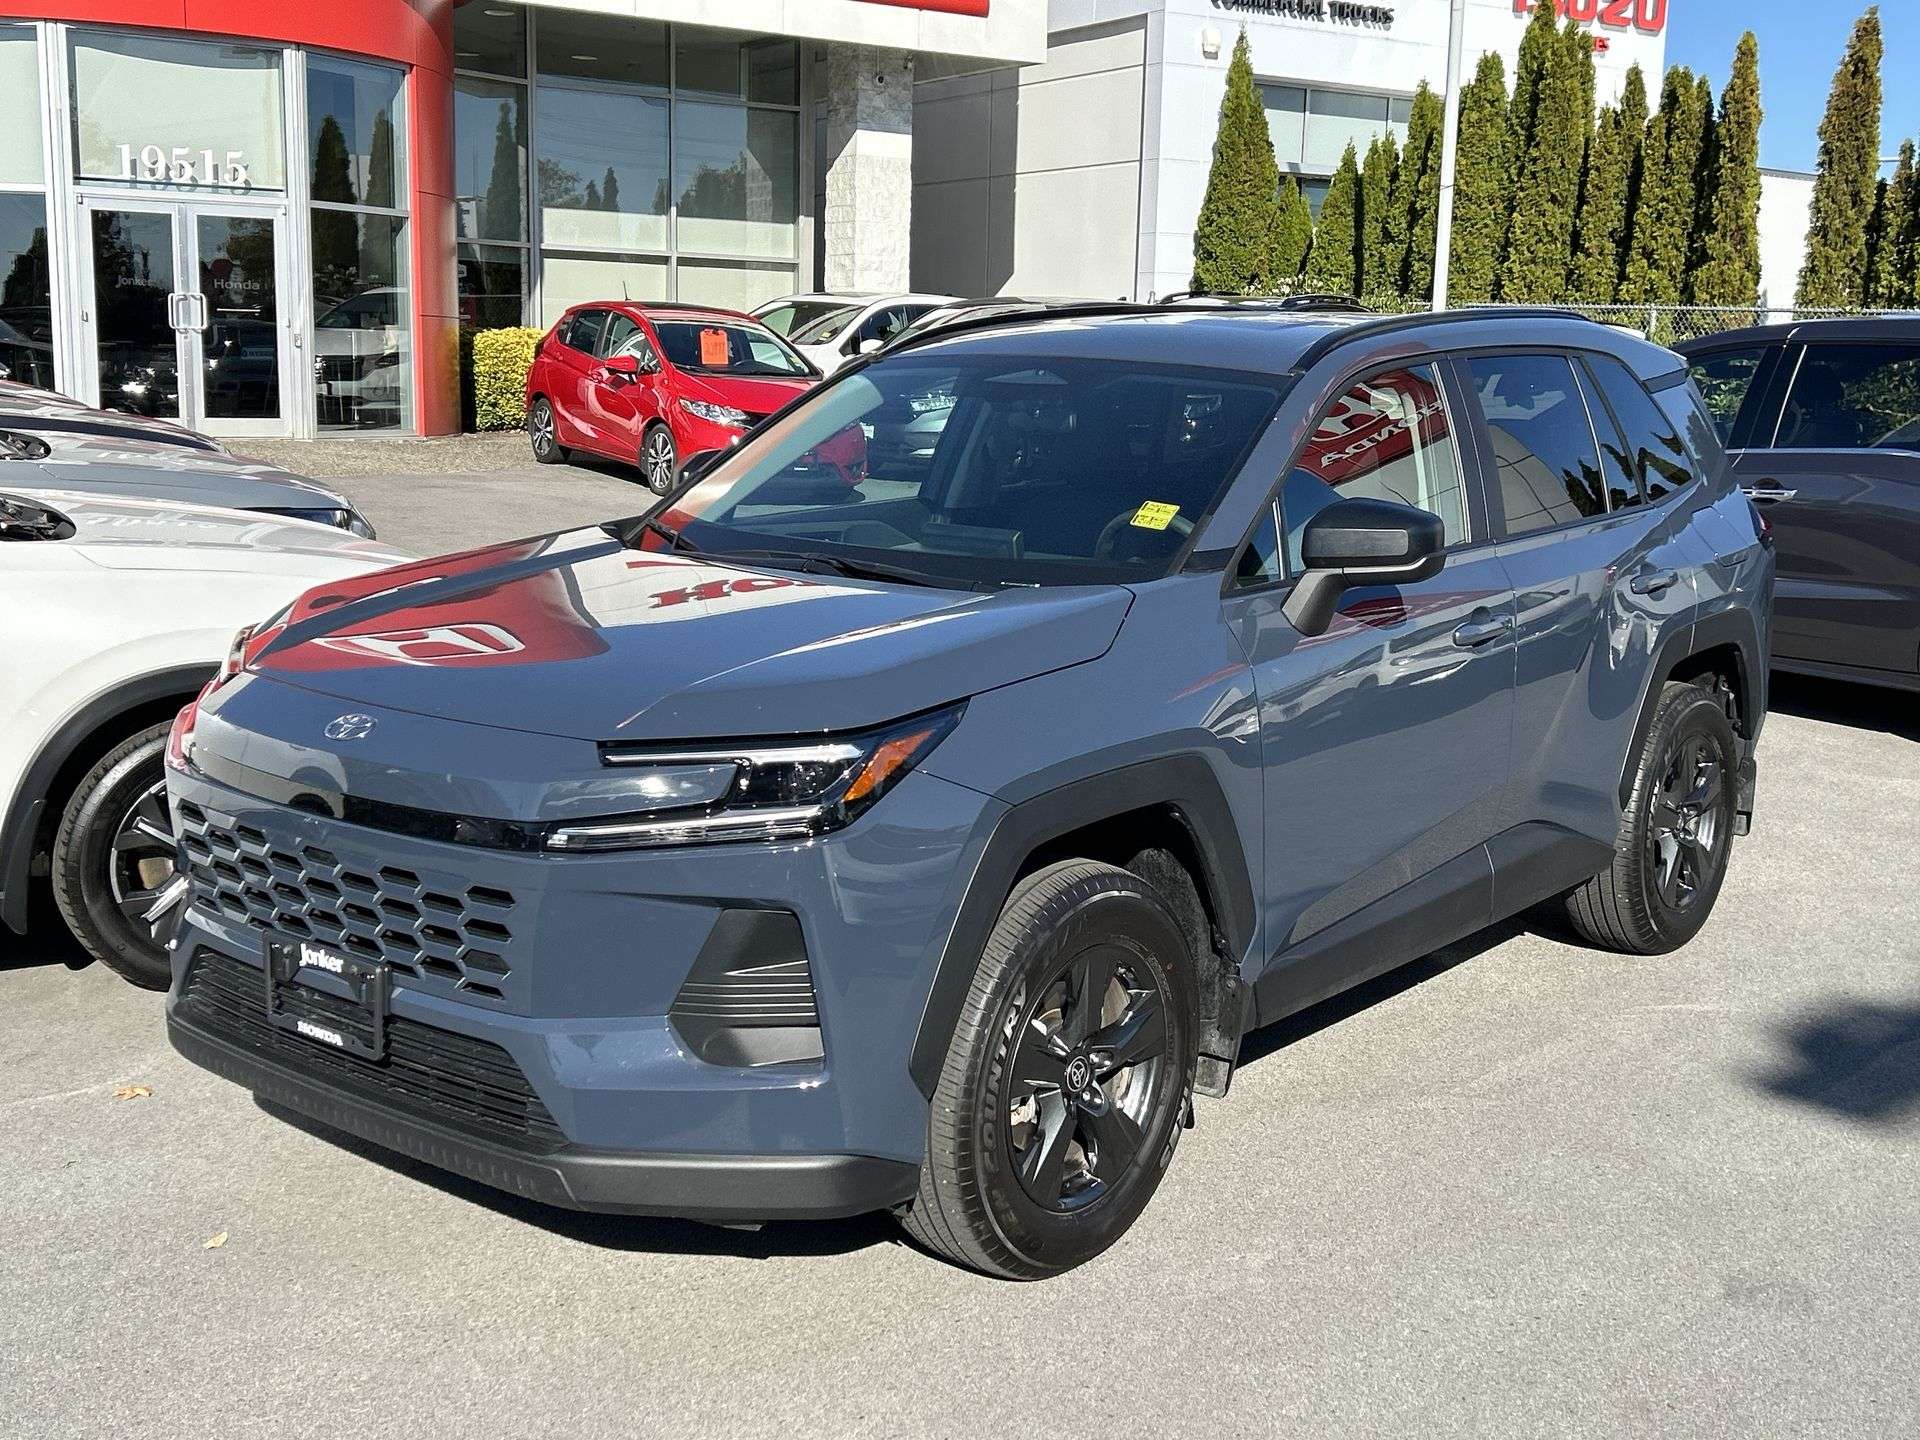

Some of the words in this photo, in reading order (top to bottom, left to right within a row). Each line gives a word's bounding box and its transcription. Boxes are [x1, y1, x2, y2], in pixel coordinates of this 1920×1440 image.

[1211, 0, 1327, 19] ERCIAL
[1513, 0, 1667, 31] UZU
[116, 144, 249, 187] 19515
[213, 278, 260, 290] Honda
[299, 943, 344, 972] Jonker
